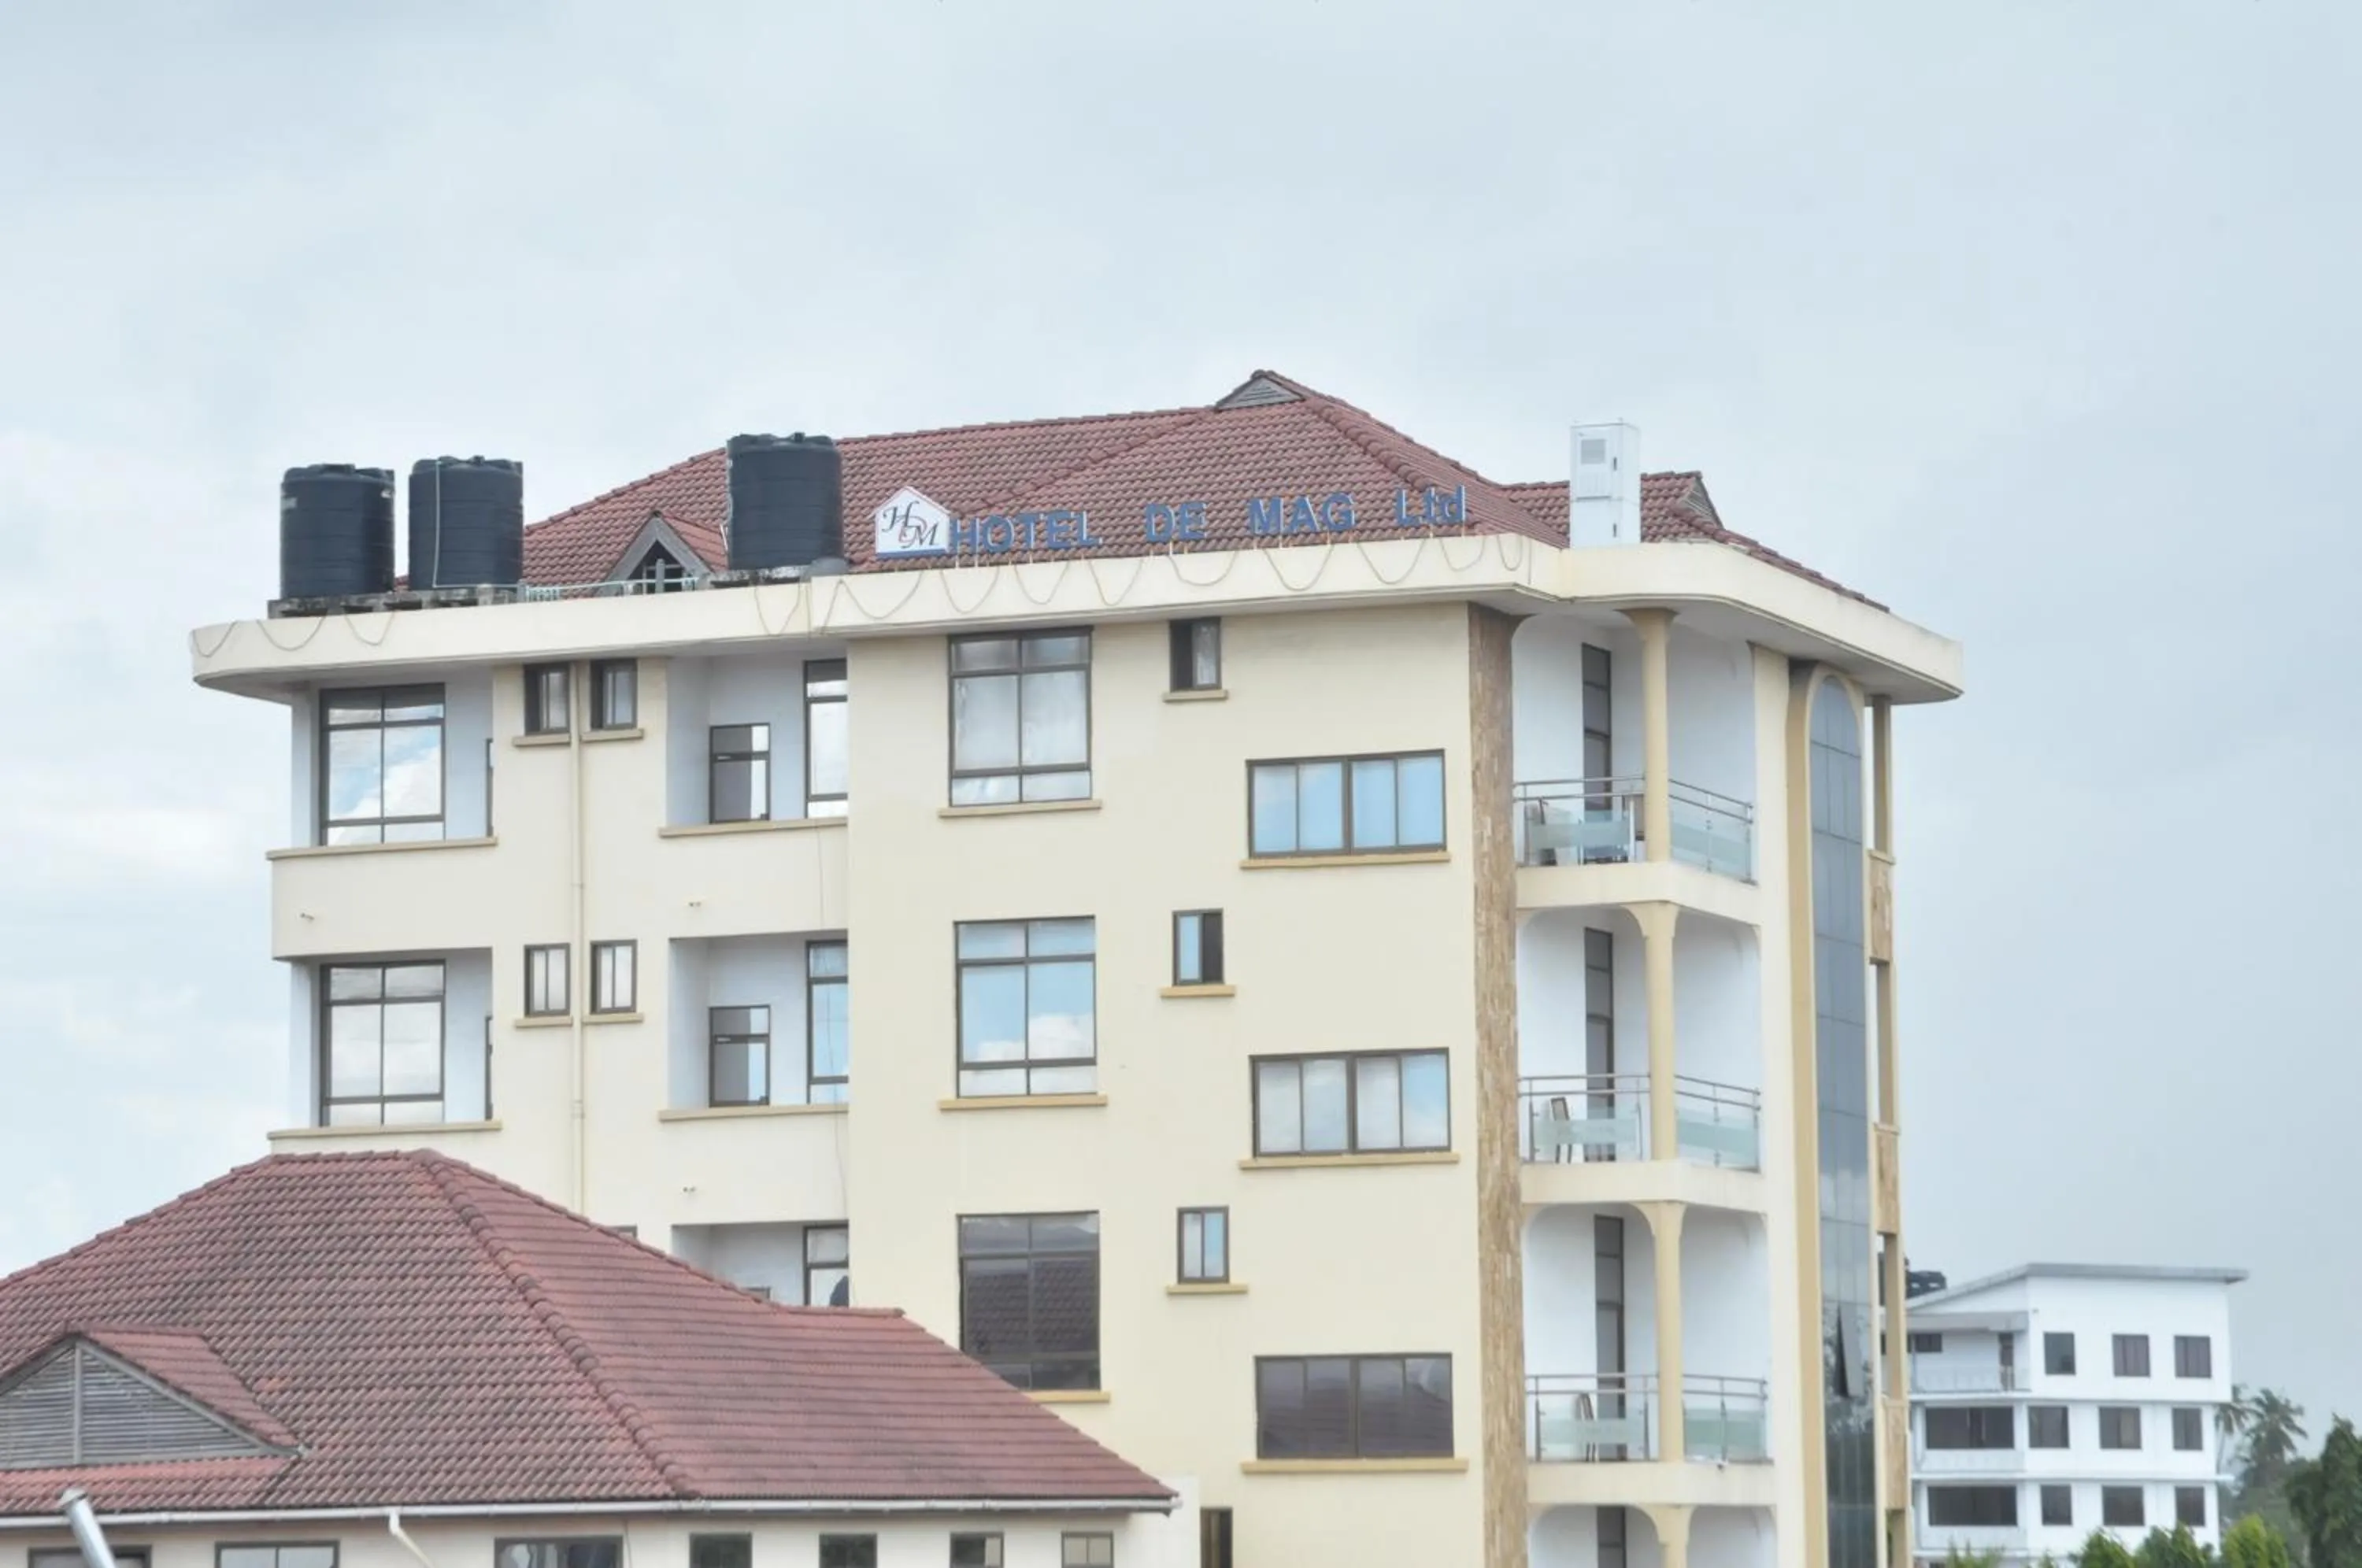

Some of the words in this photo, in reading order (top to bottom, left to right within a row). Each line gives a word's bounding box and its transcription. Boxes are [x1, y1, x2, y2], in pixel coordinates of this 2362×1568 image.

[951, 510, 1103, 553] HOTEL
[1145, 502, 1207, 542] DE
[1247, 492, 1356, 534] MAG
[1395, 485, 1466, 526] Ltd
